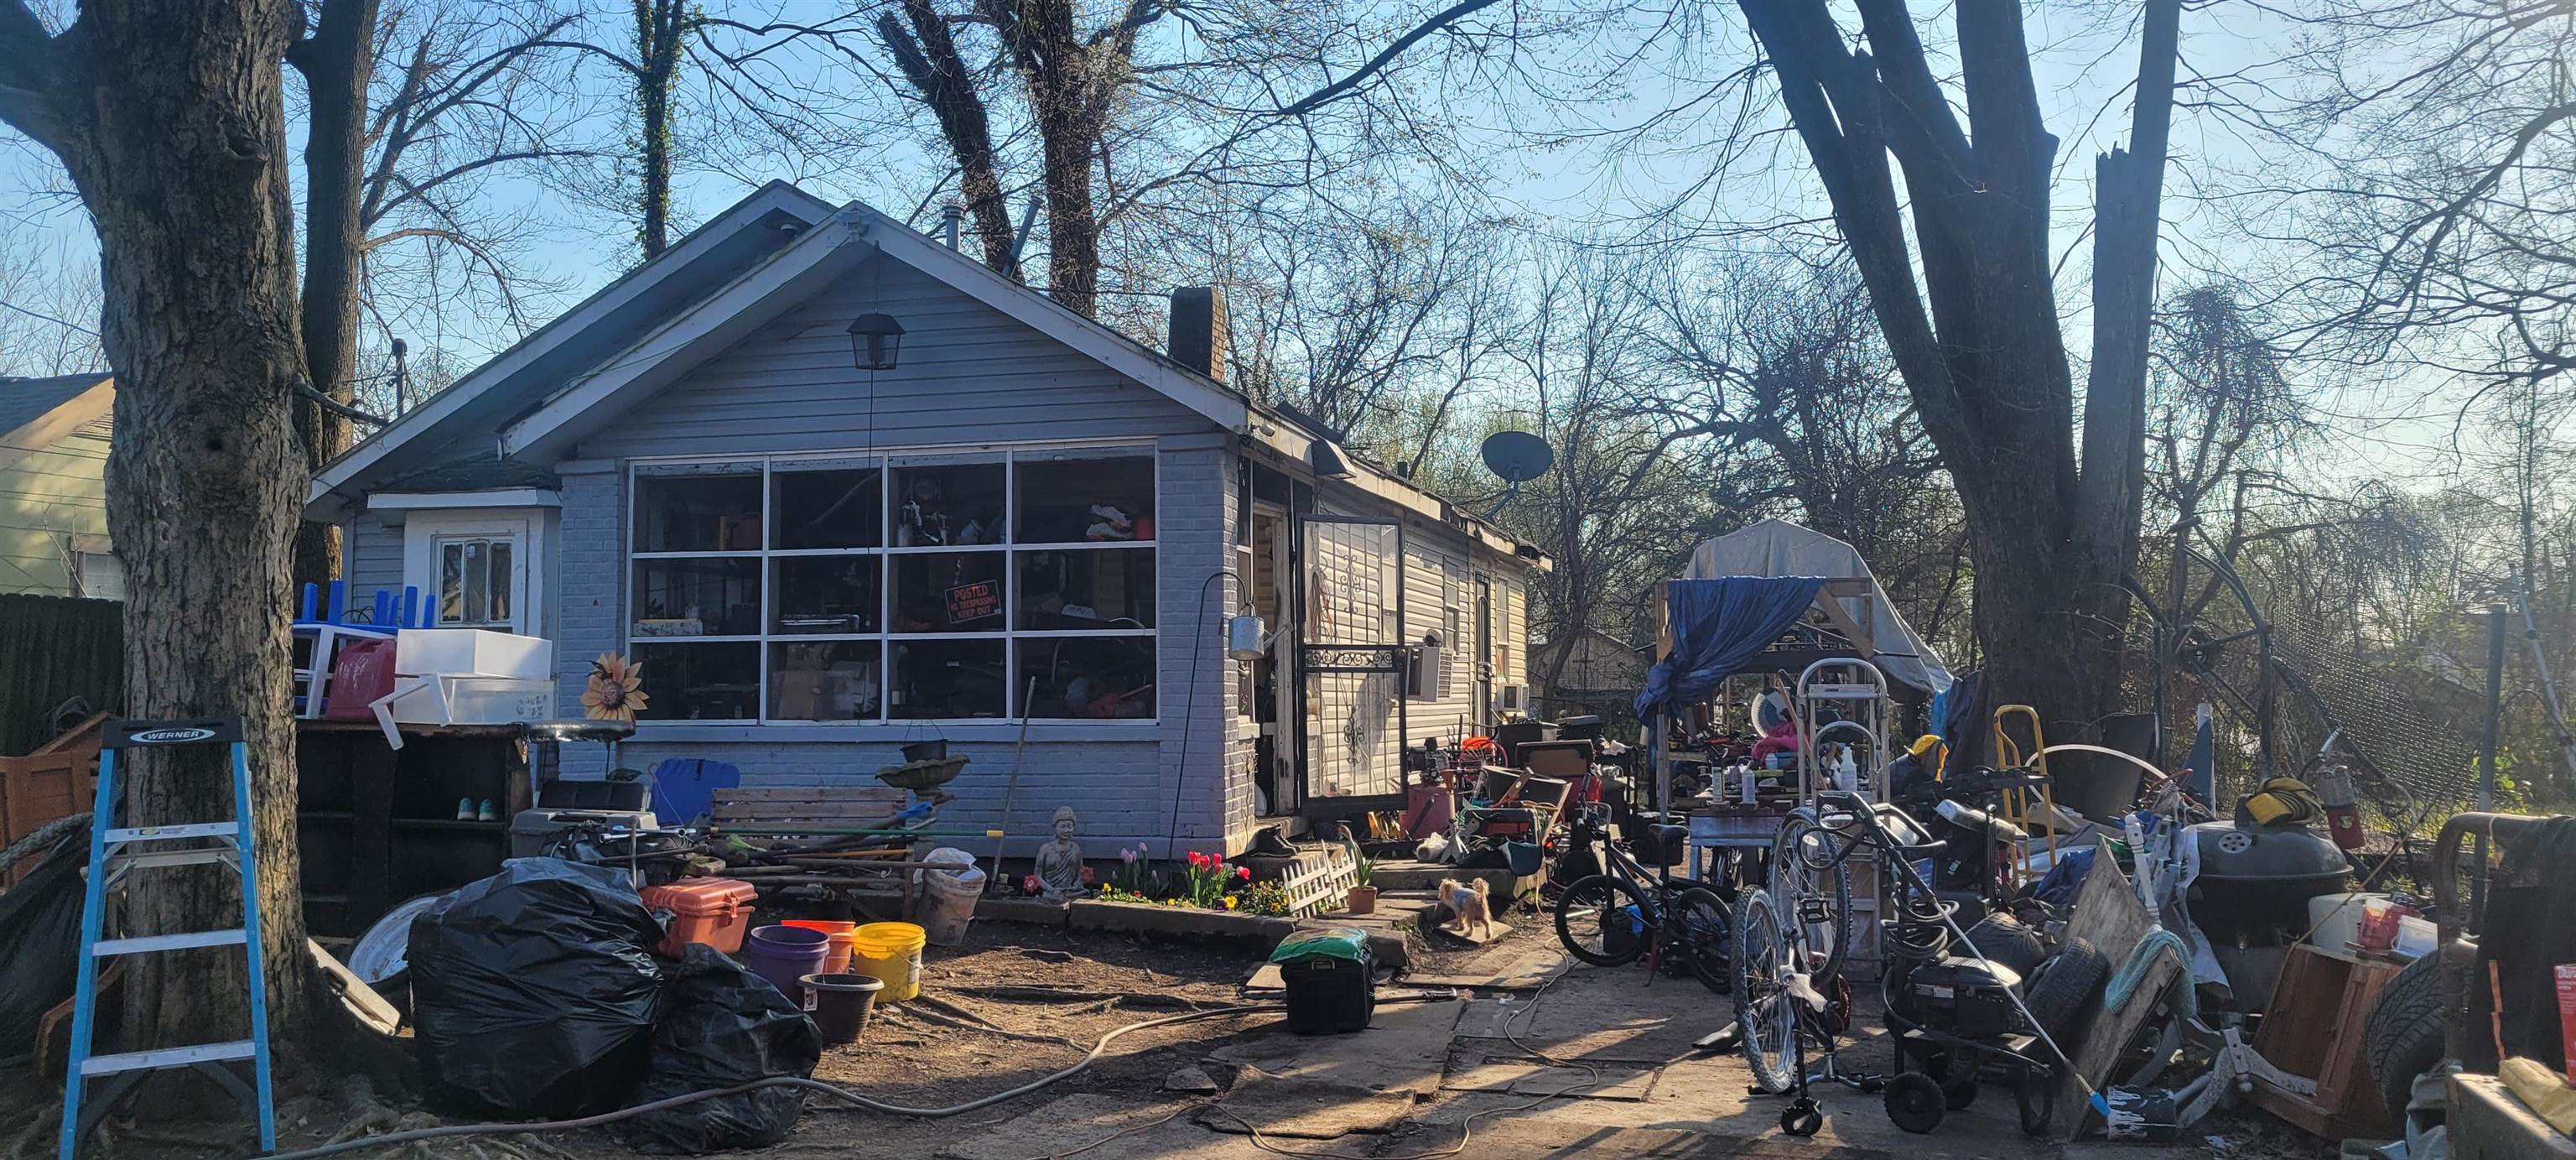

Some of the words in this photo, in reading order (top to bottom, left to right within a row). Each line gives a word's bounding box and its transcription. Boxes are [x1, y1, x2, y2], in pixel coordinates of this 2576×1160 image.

[954, 585, 988, 601] POSTED
[957, 608, 975, 618] KEEP
[977, 605, 990, 615] OUT
[148, 731, 200, 740] WERNER
